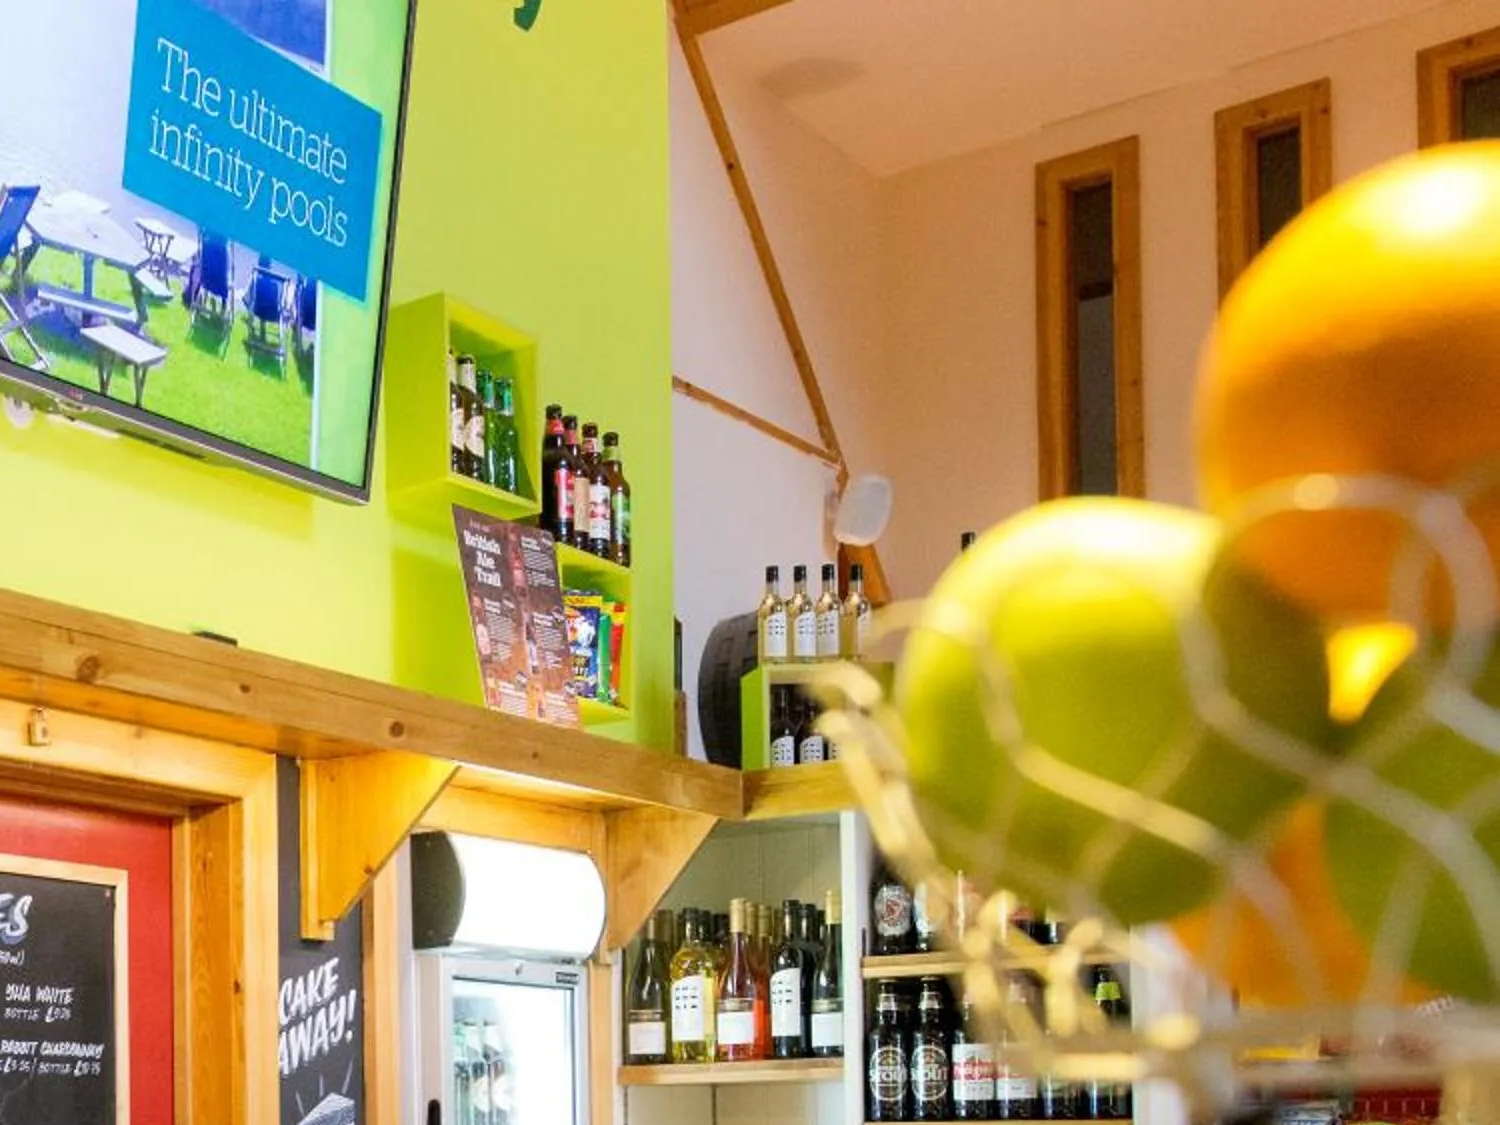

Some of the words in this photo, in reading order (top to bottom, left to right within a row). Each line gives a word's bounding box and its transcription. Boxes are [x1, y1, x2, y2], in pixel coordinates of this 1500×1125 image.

[156, 36, 222, 118] The
[228, 88, 348, 186] ultimate
[148, 107, 265, 211] infinity
[267, 176, 350, 248] pools
[35, 985, 75, 1005] WHITE
[278, 988, 357, 1077] AWAY!
[280, 957, 340, 1026] CAKE
